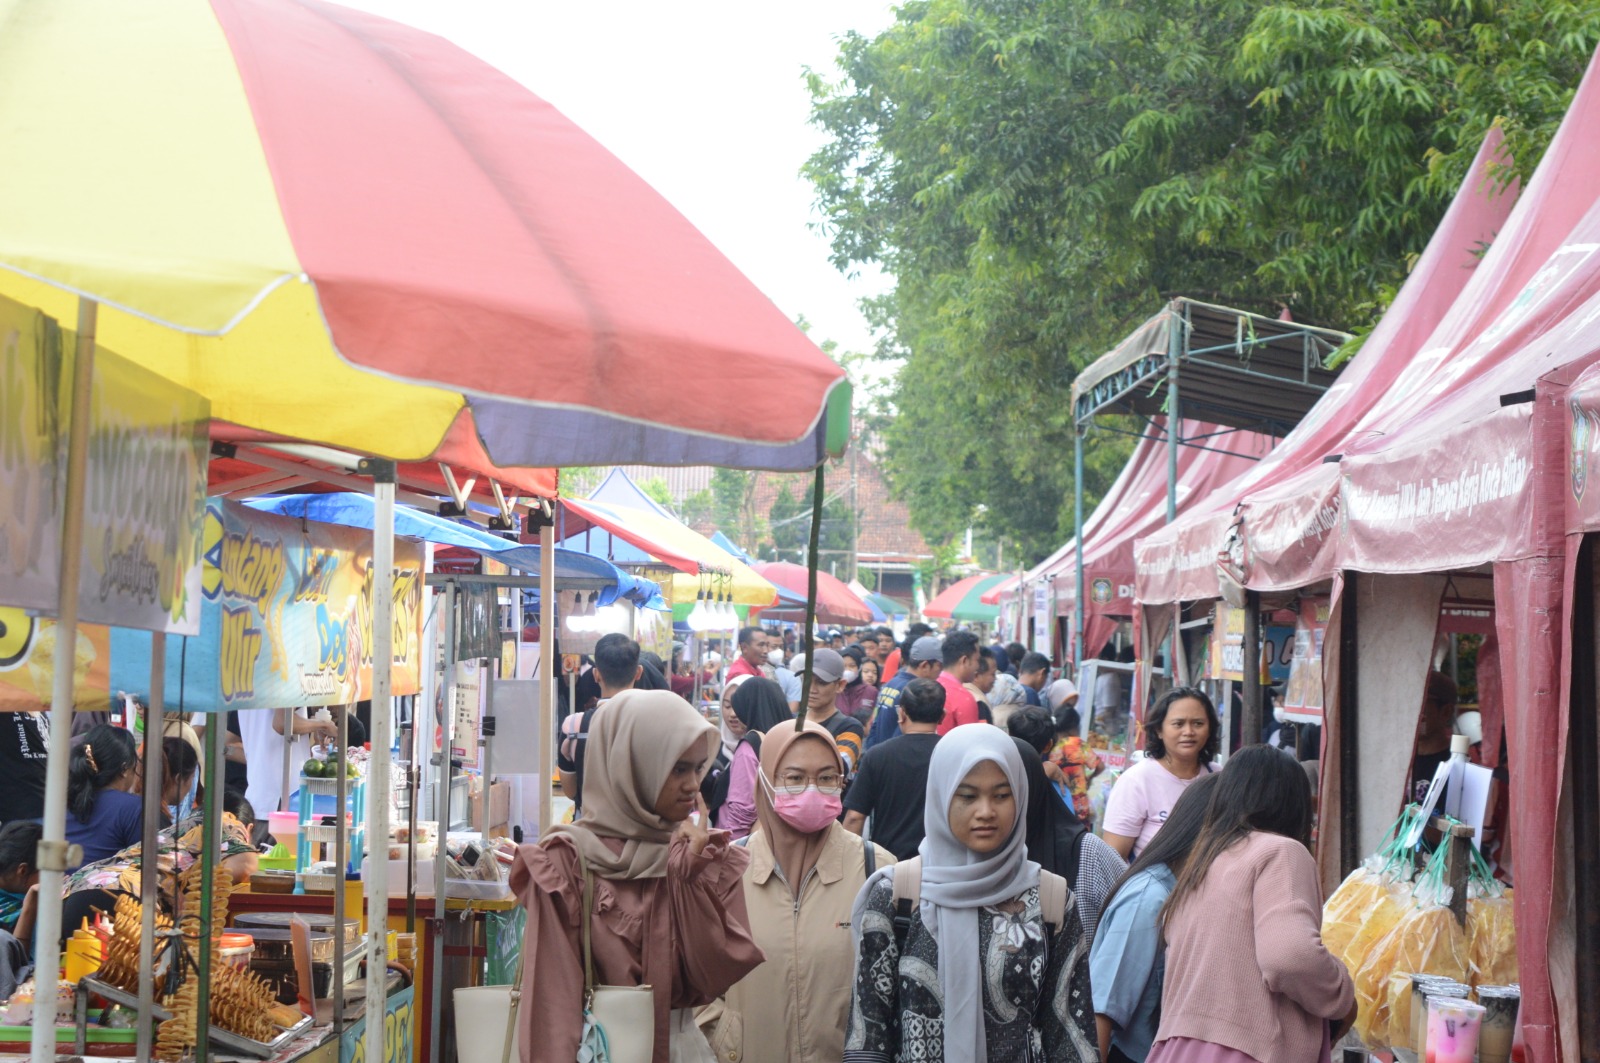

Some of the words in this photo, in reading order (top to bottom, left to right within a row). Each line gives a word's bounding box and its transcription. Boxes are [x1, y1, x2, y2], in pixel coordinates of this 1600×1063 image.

[1431, 478, 1458, 521] Tenaga
[1458, 460, 1480, 517] Kerja
[1479, 462, 1501, 503] Kota
[1500, 447, 1527, 498] Blitar
[221, 602, 262, 702] Ulir
[316, 602, 350, 683] Dog
